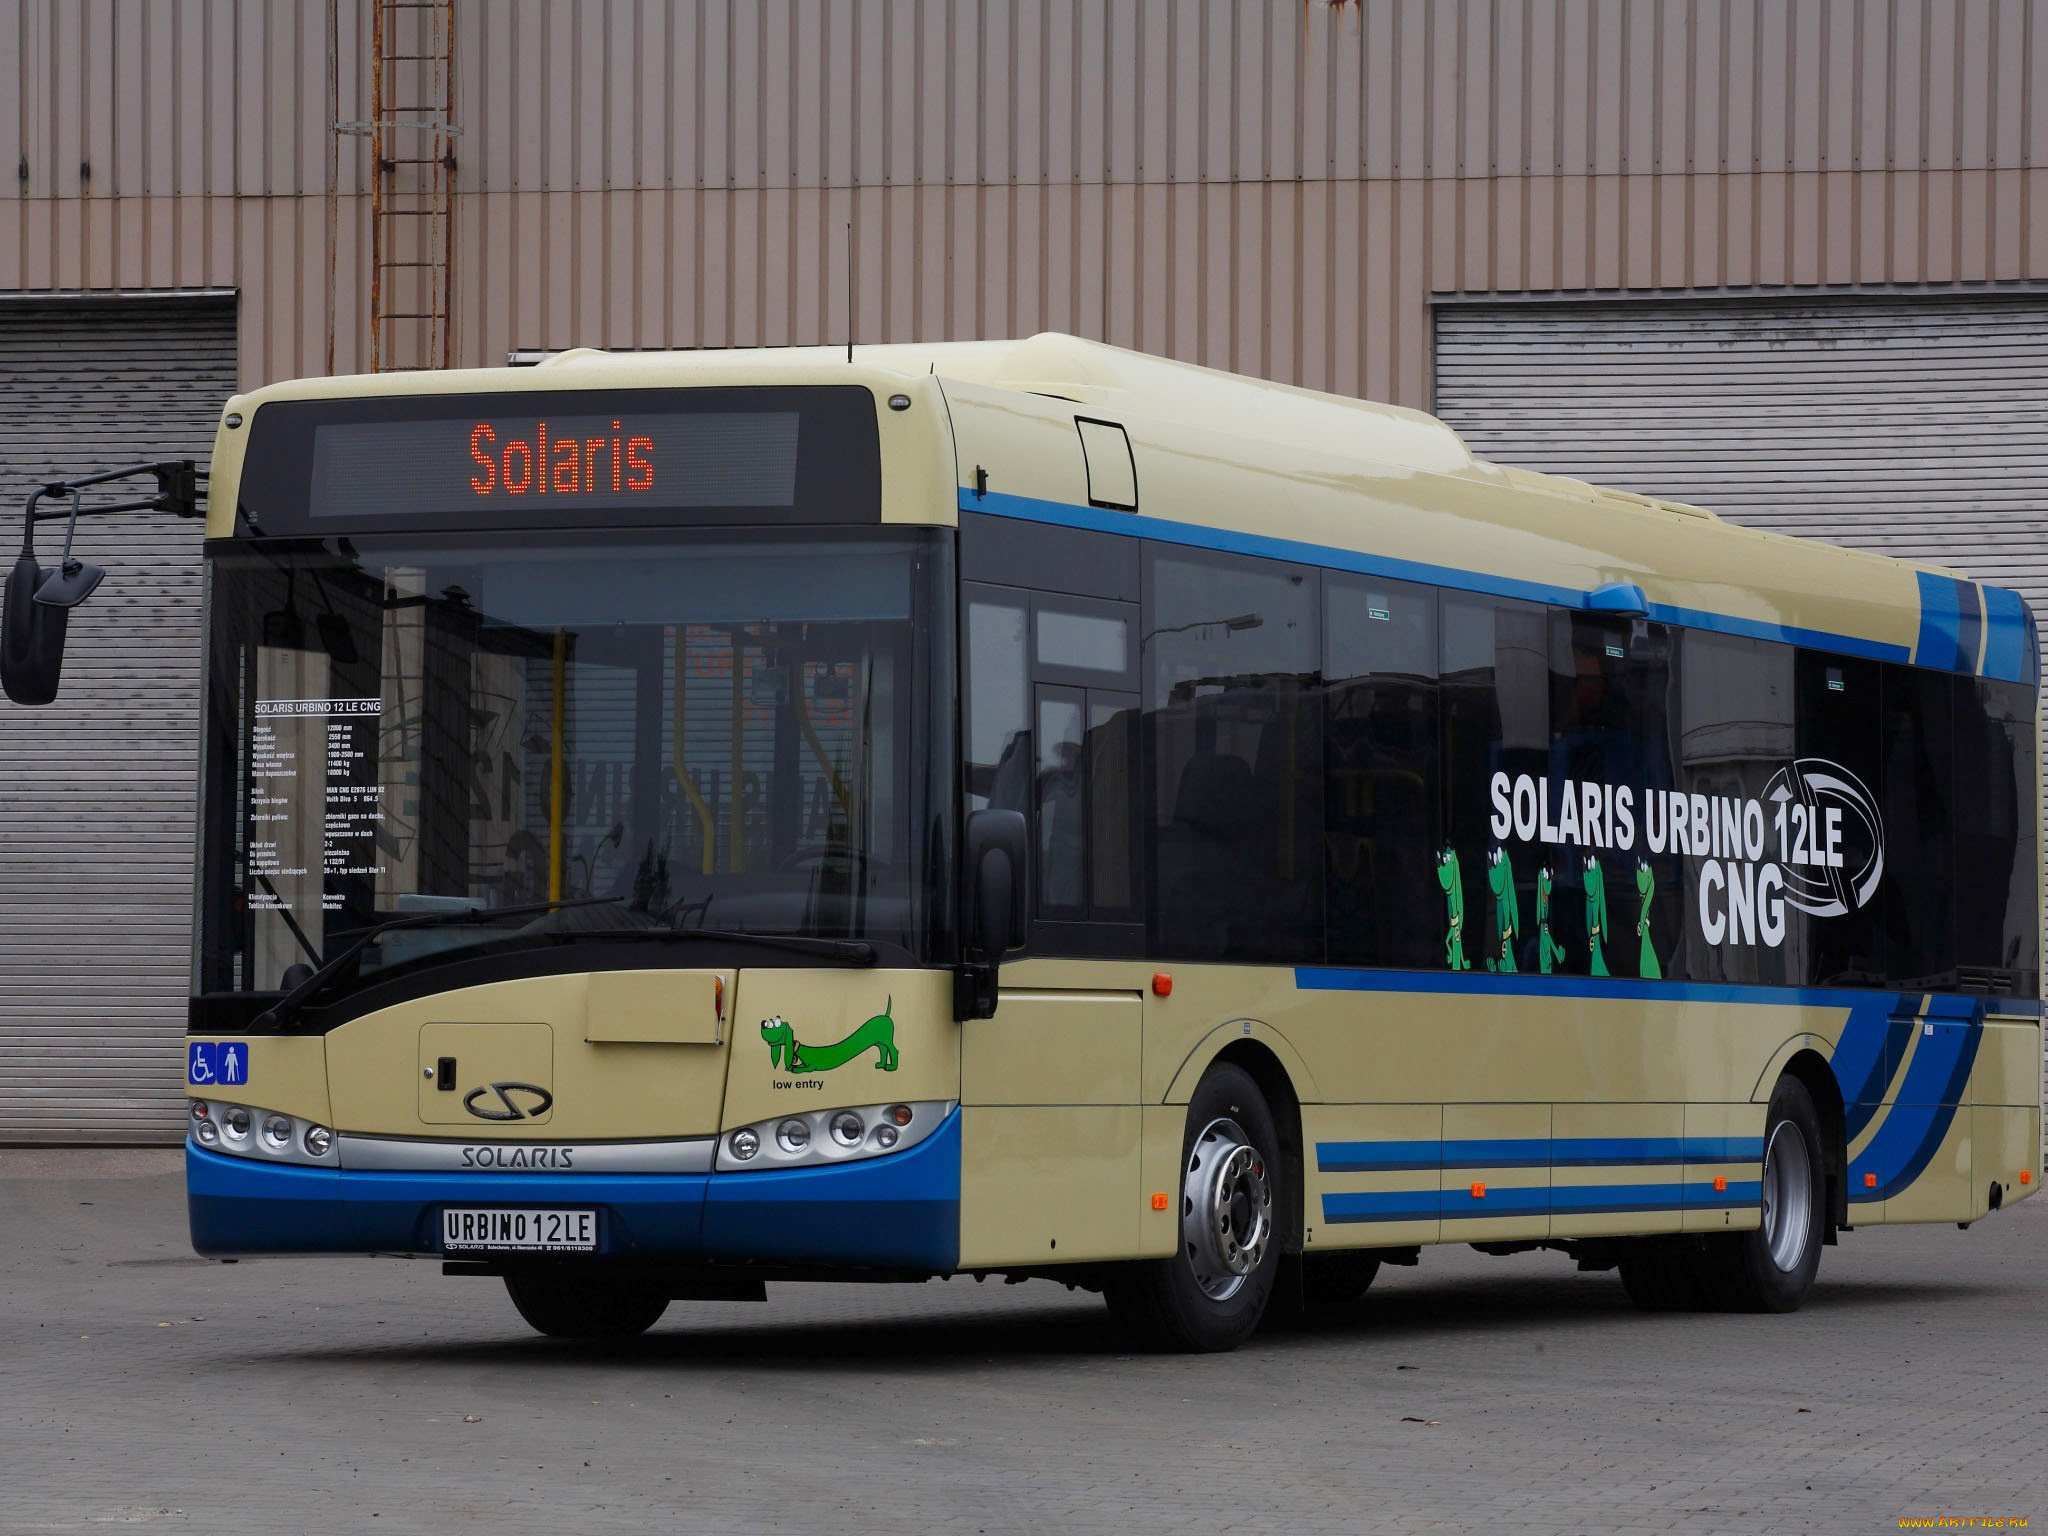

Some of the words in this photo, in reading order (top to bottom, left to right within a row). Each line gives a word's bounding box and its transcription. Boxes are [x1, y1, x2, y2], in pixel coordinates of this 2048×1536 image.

[471, 420, 654, 494] Solaris
[255, 703, 293, 713] SOLARIS
[296, 702, 331, 712] URBINO
[334, 702, 343, 711] 12
[346, 702, 358, 711] LE
[360, 701, 380, 711] CNG
[1490, 771, 1635, 851] SOLARIS
[1645, 788, 1764, 860] URBINO
[1774, 801, 1844, 868] 12LE
[1700, 859, 1785, 948] CNG
[773, 1080, 792, 1089] low
[795, 1080, 824, 1090] entry
[461, 1147, 573, 1168] SOLARIS
